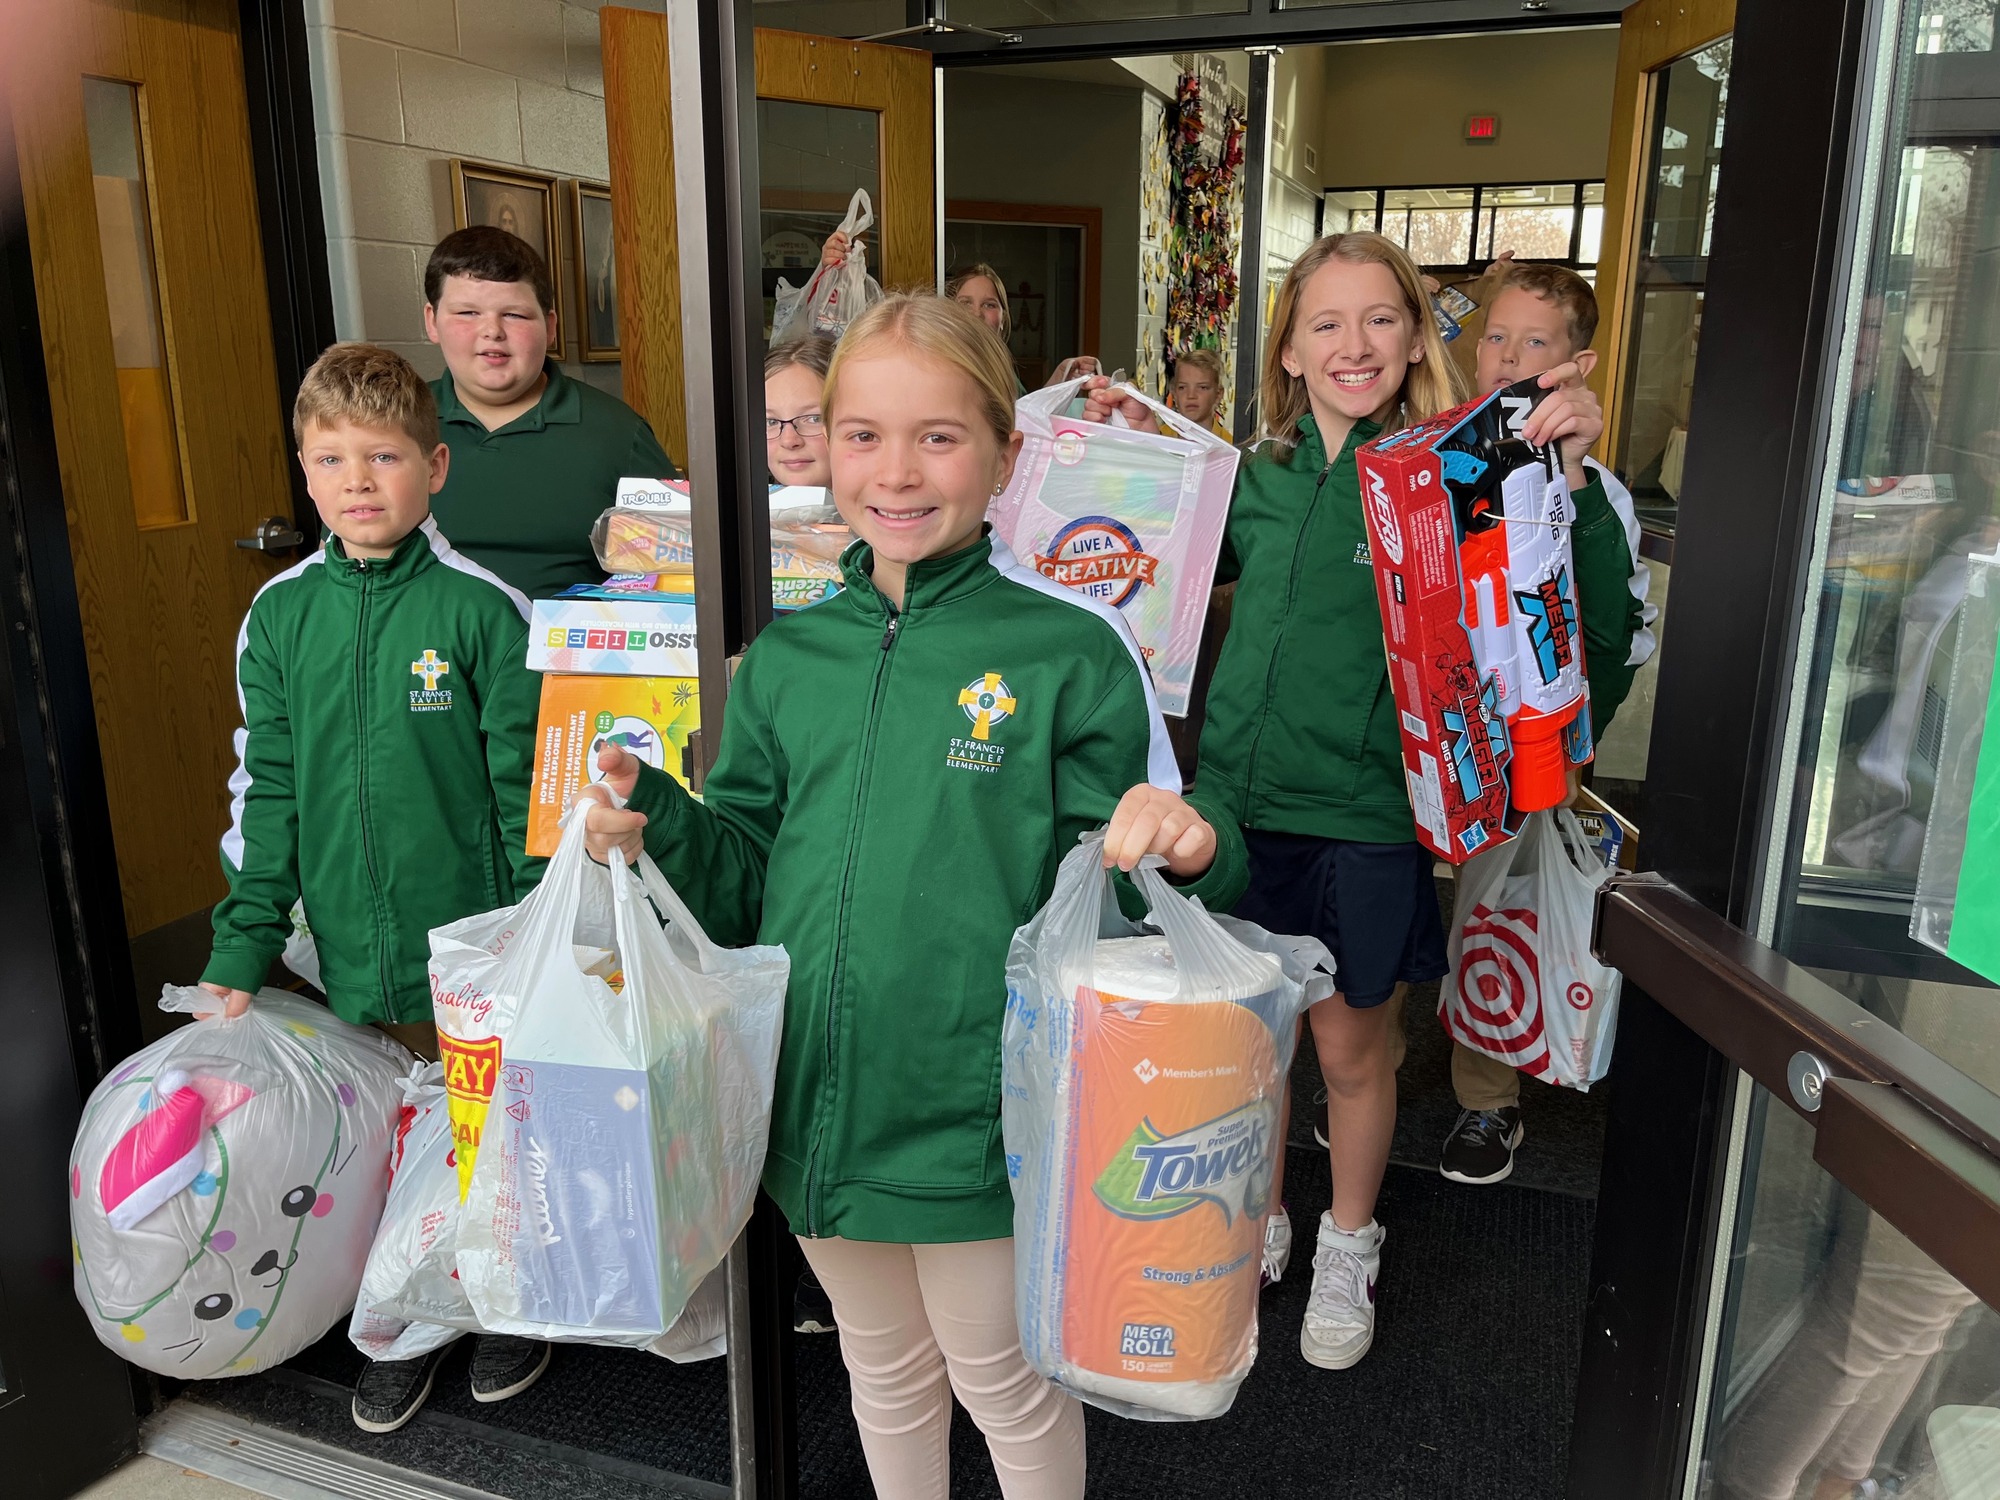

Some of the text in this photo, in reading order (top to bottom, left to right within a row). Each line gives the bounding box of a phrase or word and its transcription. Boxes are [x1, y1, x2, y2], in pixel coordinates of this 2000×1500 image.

[622, 489, 671, 506] TROUBLE
[1552, 492, 1565, 523] BIG
[1365, 466, 1404, 565] NERF
[1548, 510, 1561, 541] RIG
[1073, 536, 1114, 554] LIVE A
[1040, 557, 1150, 582] CREATIVE
[1540, 579, 1573, 668] MEGA
[409, 690, 452, 698] ST. FRANCIS
[566, 714, 578, 771] MAINTENANT
[573, 711, 587, 776] EXPLORATEURS
[950, 738, 1005, 755] ST. FRANCIS
[1461, 695, 1499, 788] MEGA
[539, 726, 554, 805] NOW WELCOMING
[548, 728, 562, 804] LITTLE EXPLORERS
[946, 758, 1000, 773] ELEMENTARY
[948, 747, 1002, 763] XAVIER
[1440, 740, 1458, 784] BIG RIG
[1163, 1067, 1214, 1079] Member's
[1207, 1125, 1249, 1148] Premium
[1217, 1119, 1245, 1137] Super
[1132, 1117, 1266, 1202] Towels
[1142, 1267, 1192, 1285] Strong
[1195, 1268, 1205, 1280] &
[1123, 1325, 1174, 1340] MEGA
[1122, 1338, 1174, 1356] ROLL
[1121, 1359, 1145, 1372] 150
